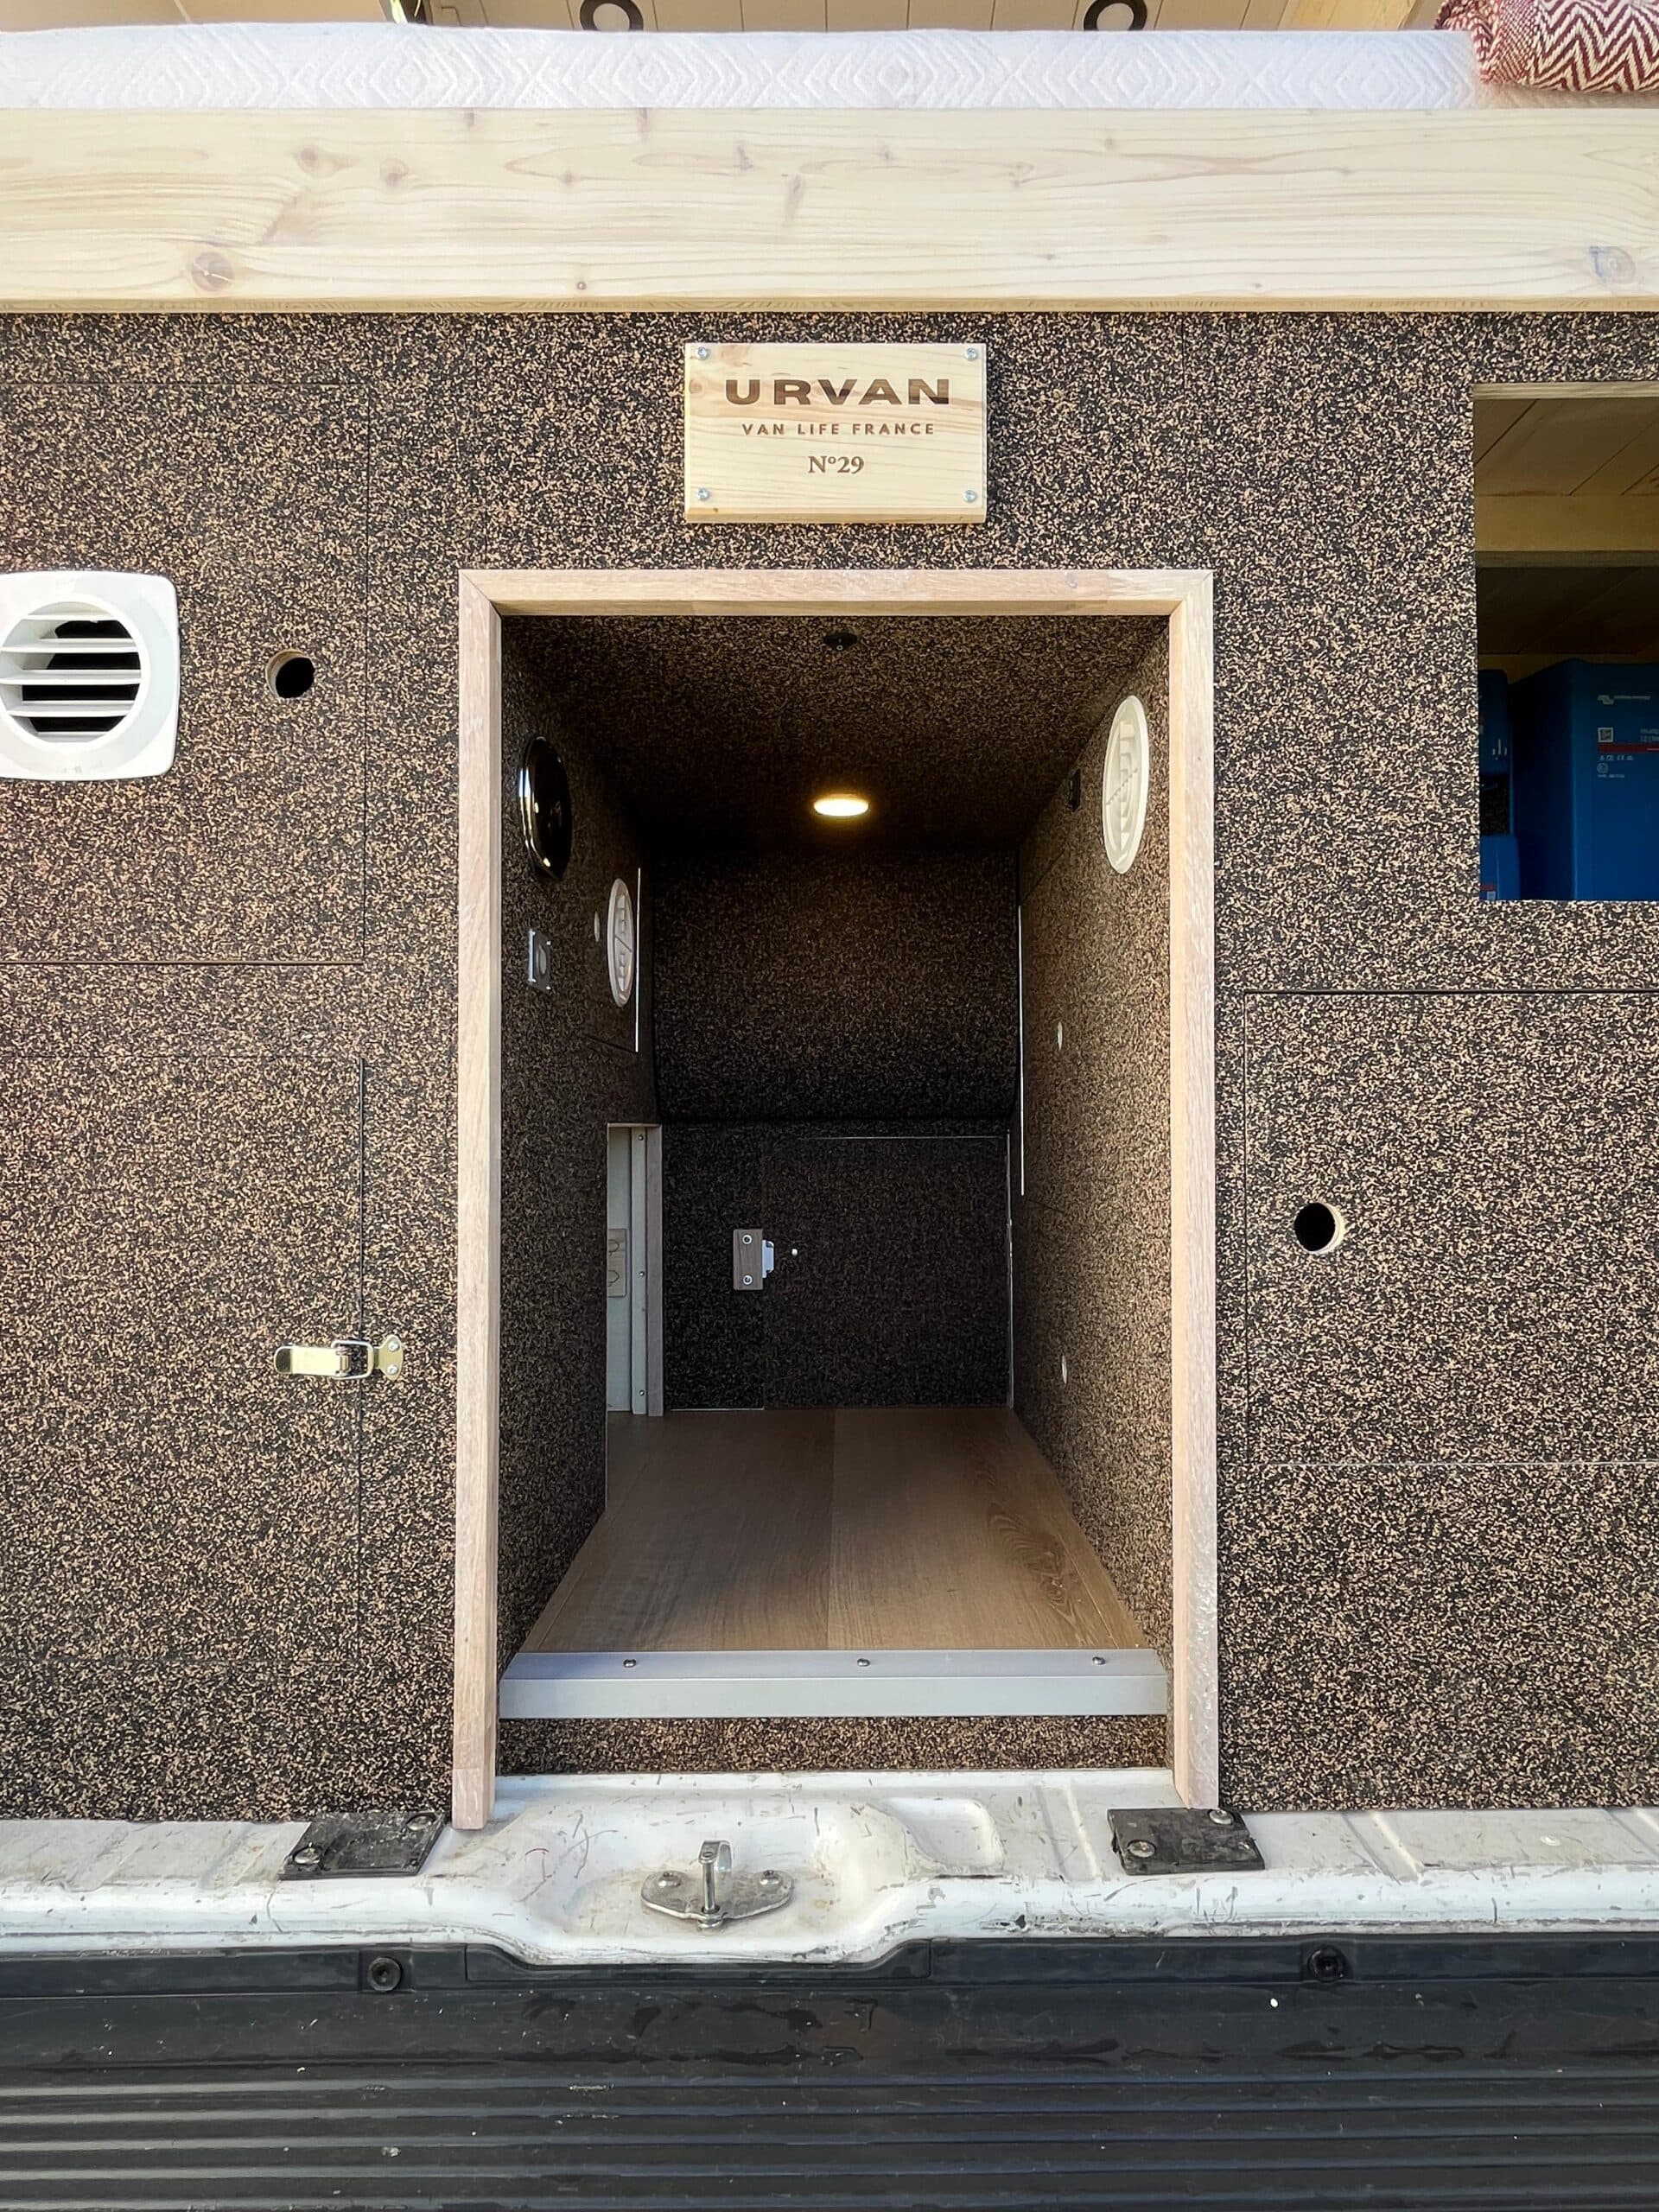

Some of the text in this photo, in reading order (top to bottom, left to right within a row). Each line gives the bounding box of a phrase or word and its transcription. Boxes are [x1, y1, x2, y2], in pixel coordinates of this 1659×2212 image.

[726, 378, 950, 405] URVAN
[741, 423, 934, 435] VAN LIFE FRANCE
